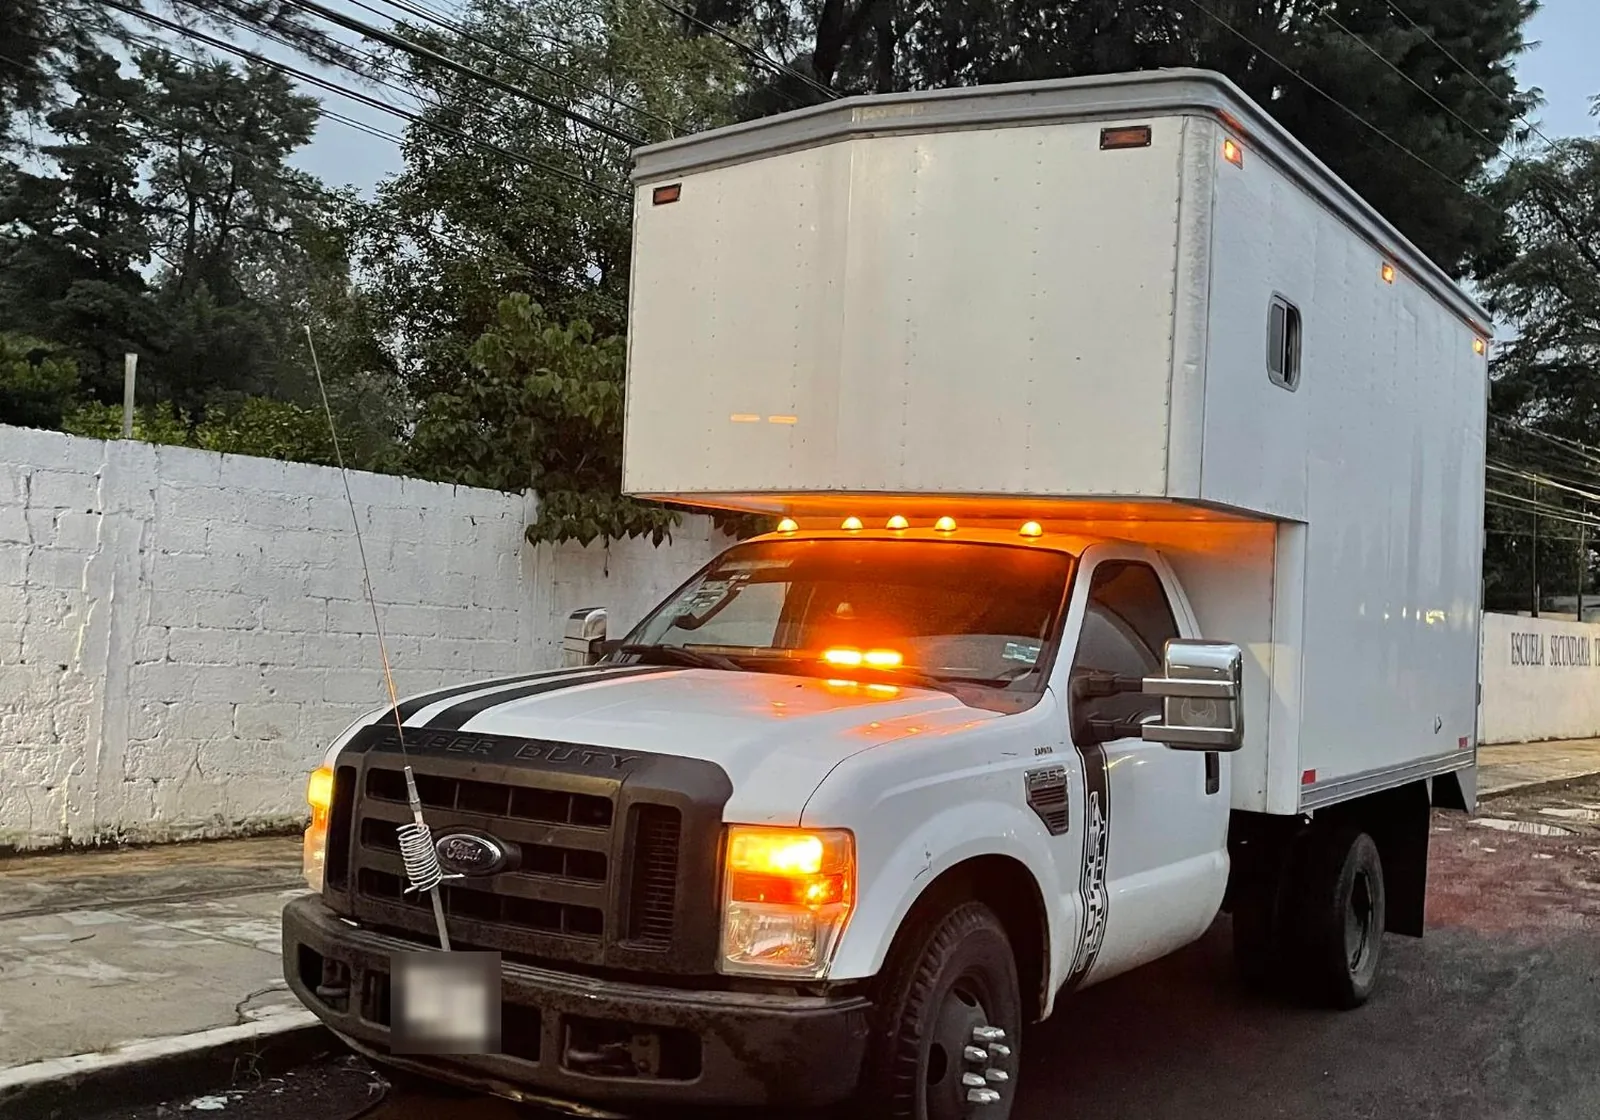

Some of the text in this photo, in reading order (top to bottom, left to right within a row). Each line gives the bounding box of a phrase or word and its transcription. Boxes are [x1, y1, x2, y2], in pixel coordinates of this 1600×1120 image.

[1511, 632, 1545, 666] ESCUELA
[1550, 634, 1591, 667] SECUNDARIA
[513, 741, 639, 770] DUTY
[446, 839, 482, 861] Ford
